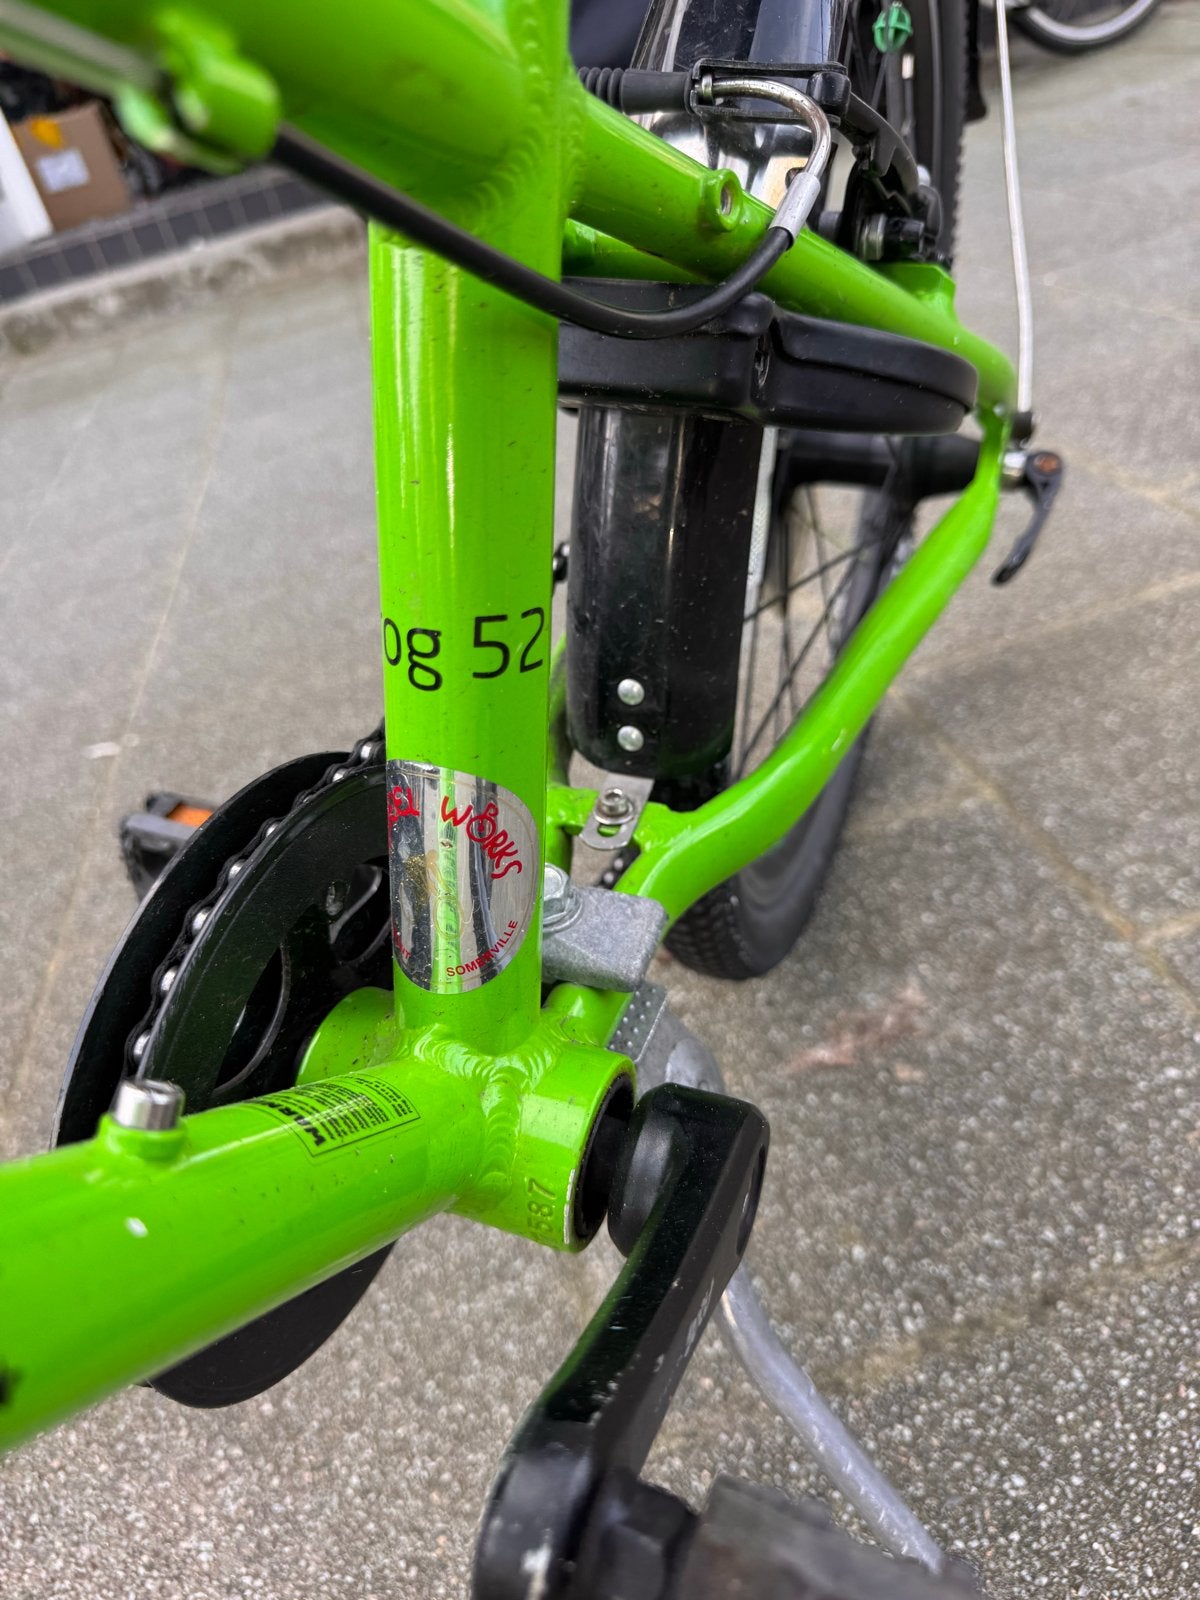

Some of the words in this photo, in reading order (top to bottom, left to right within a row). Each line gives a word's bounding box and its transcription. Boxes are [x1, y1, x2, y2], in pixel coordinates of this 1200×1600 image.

[472, 606, 545, 680] 52
[440, 795, 523, 880] WORKS
[446, 919, 519, 977] SOMERVILLE
